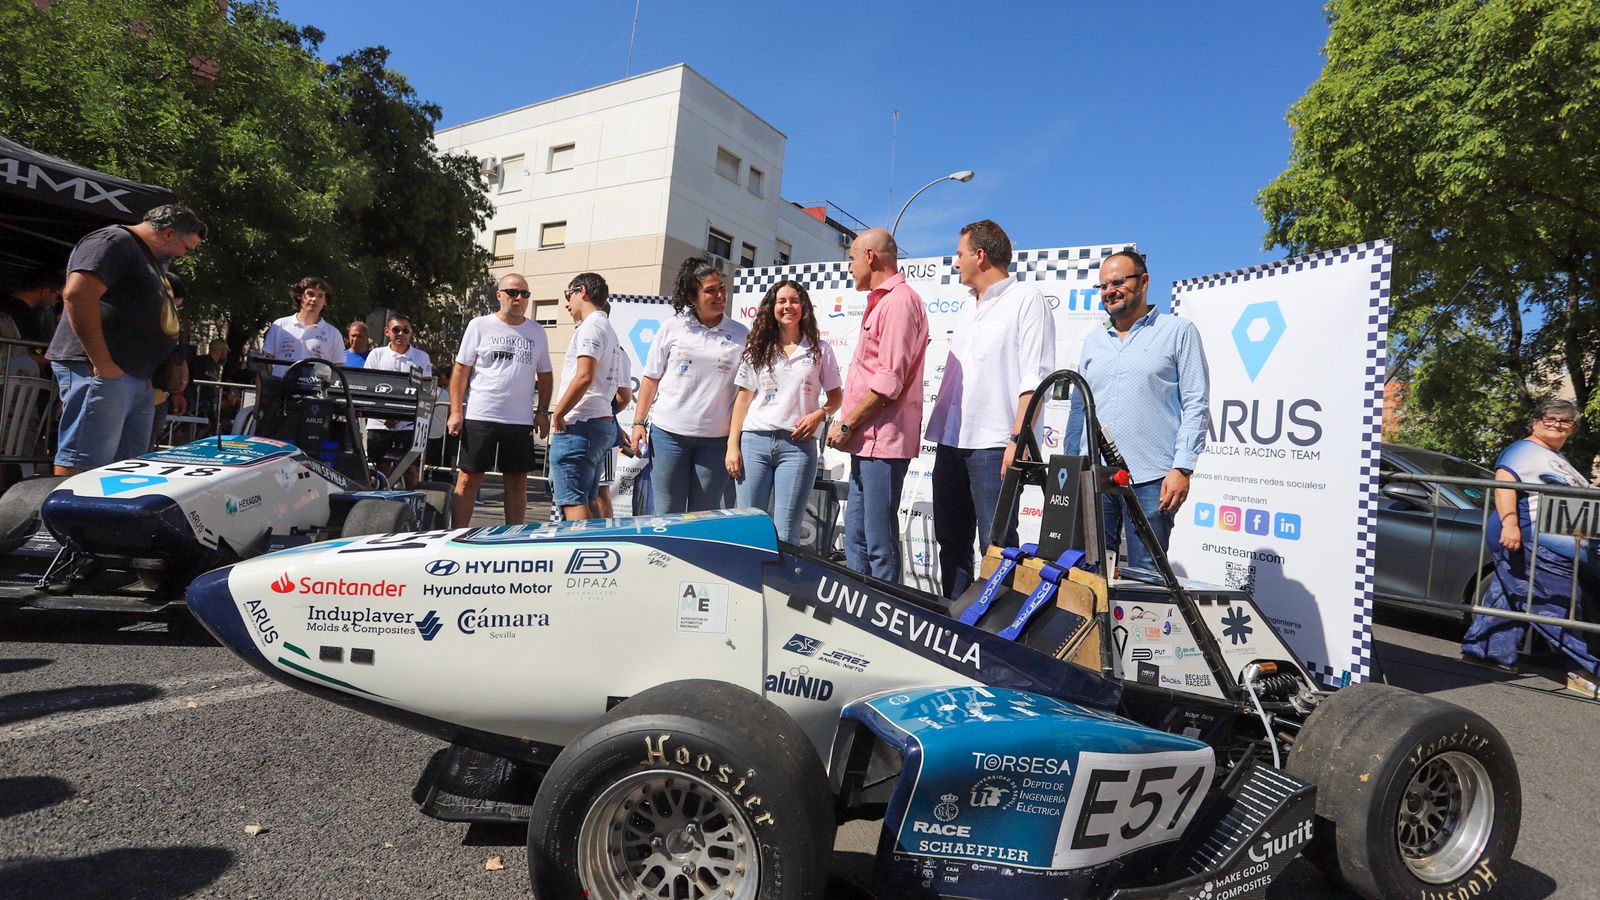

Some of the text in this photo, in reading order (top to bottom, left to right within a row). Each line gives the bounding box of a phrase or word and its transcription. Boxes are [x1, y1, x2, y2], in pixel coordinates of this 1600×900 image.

[1203, 445, 1321, 460] ALUCIA RACING TEAM
[105, 461, 222, 477] 218
[1213, 473, 1222, 481] en
[1223, 475, 1259, 485] nuestras
[1259, 478, 1285, 487] redes
[1286, 480, 1327, 491] sociales!
[238, 494, 262, 508] HEXAGON
[1050, 494, 1070, 506] ARUS
[1222, 493, 1268, 505] @arusteam
[189, 510, 206, 535] ARUS
[1201, 542, 1286, 565] arusteam.com
[465, 560, 553, 573] HYUNDAI
[299, 576, 406, 598] Santander
[423, 583, 552, 598] Hyundauto Motor
[566, 578, 618, 588] DIPAZA
[979, 559, 1013, 604] sparco
[308, 605, 414, 625] Induplaver
[1011, 582, 1053, 630] sparco
[246, 600, 279, 644] ARUS
[307, 623, 416, 635] Molds & Composites
[457, 607, 550, 635] Cámara
[816, 575, 981, 669] UNI SEVILLA
[489, 631, 516, 640] Sevilla
[818, 656, 864, 673] ANGEL NIETO
[823, 650, 871, 667] JEREZ
[764, 671, 834, 702] aluNID
[972, 752, 1072, 776] TORSESA
[640, 734, 776, 826] Hoosier
[1053, 782, 1065, 791] DE
[1070, 766, 1206, 850] E51
[913, 820, 972, 837] RACE
[1248, 819, 1314, 863] Gurit
[919, 840, 1029, 863] SCHAEFFLER
[1243, 861, 1270, 878] GOOD
[1216, 874, 1272, 900] COMPOSITES
